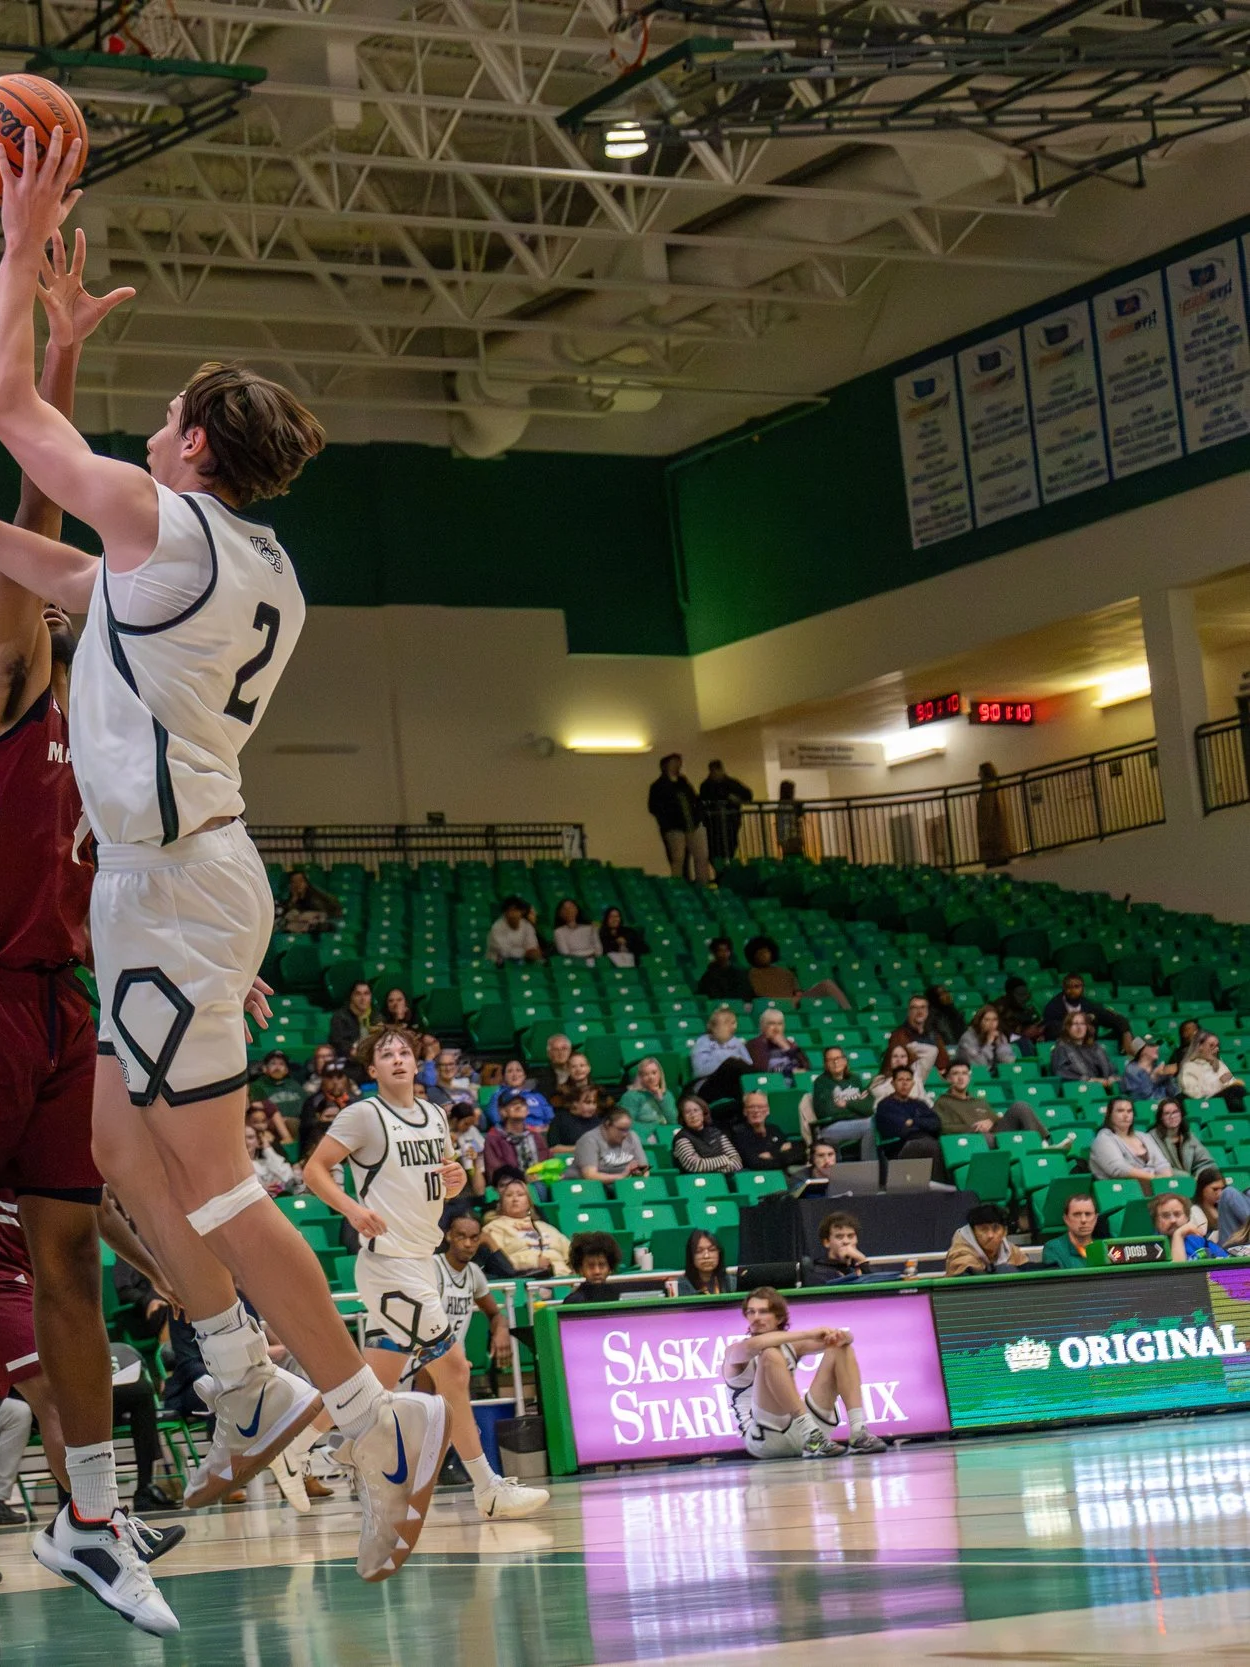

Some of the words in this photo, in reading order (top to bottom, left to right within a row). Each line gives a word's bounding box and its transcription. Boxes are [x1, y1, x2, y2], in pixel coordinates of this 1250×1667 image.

[224, 601, 280, 725] 2
[424, 1171, 441, 1201] 10
[1059, 1324, 1247, 1369] ORIGINAL
